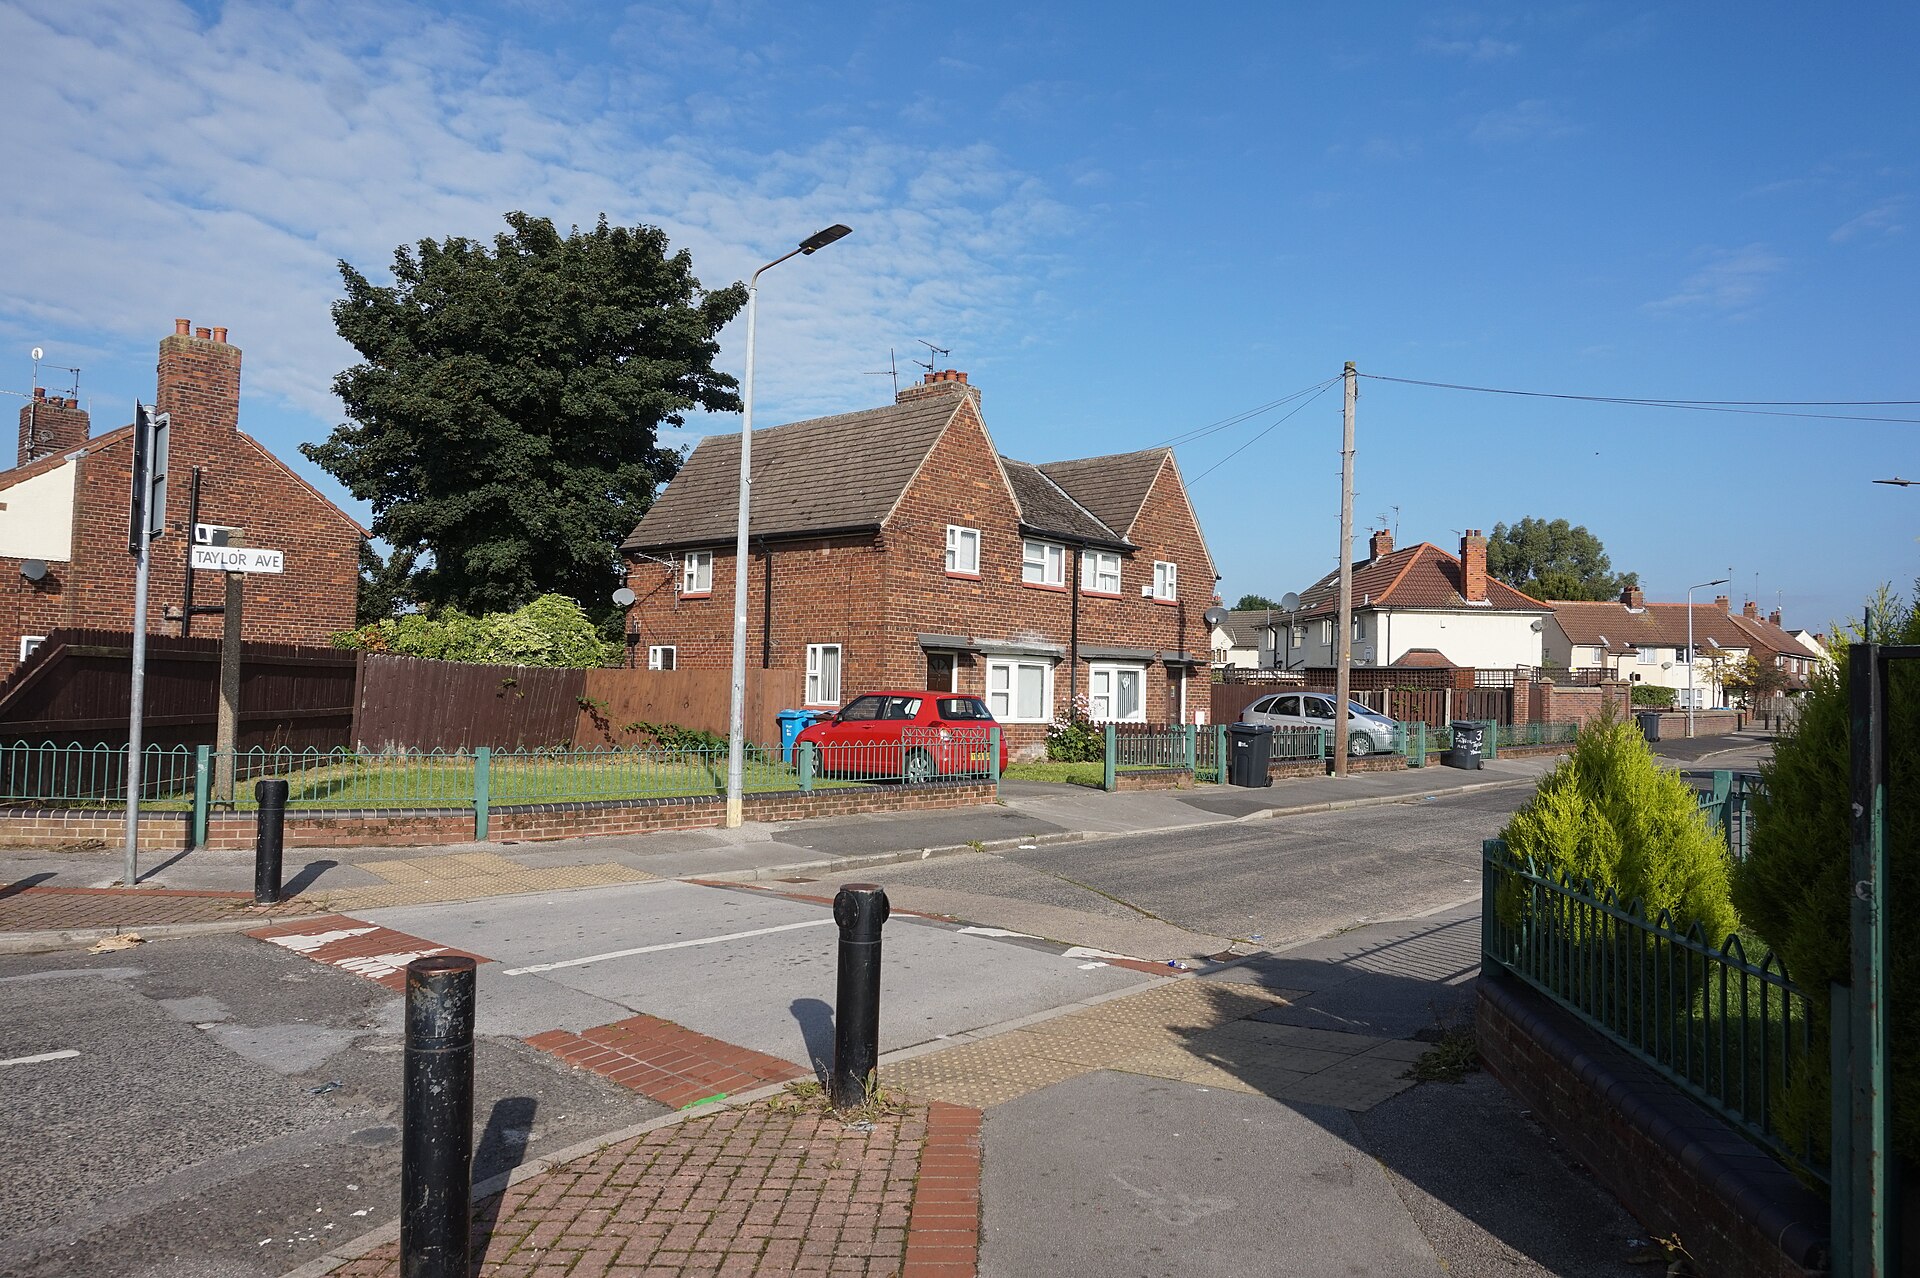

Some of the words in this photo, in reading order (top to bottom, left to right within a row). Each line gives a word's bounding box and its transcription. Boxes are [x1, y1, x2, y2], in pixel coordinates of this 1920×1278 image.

[196, 551, 247, 566] TAYLOR
[255, 555, 280, 568] AVE
[1475, 730, 1483, 741] 3
